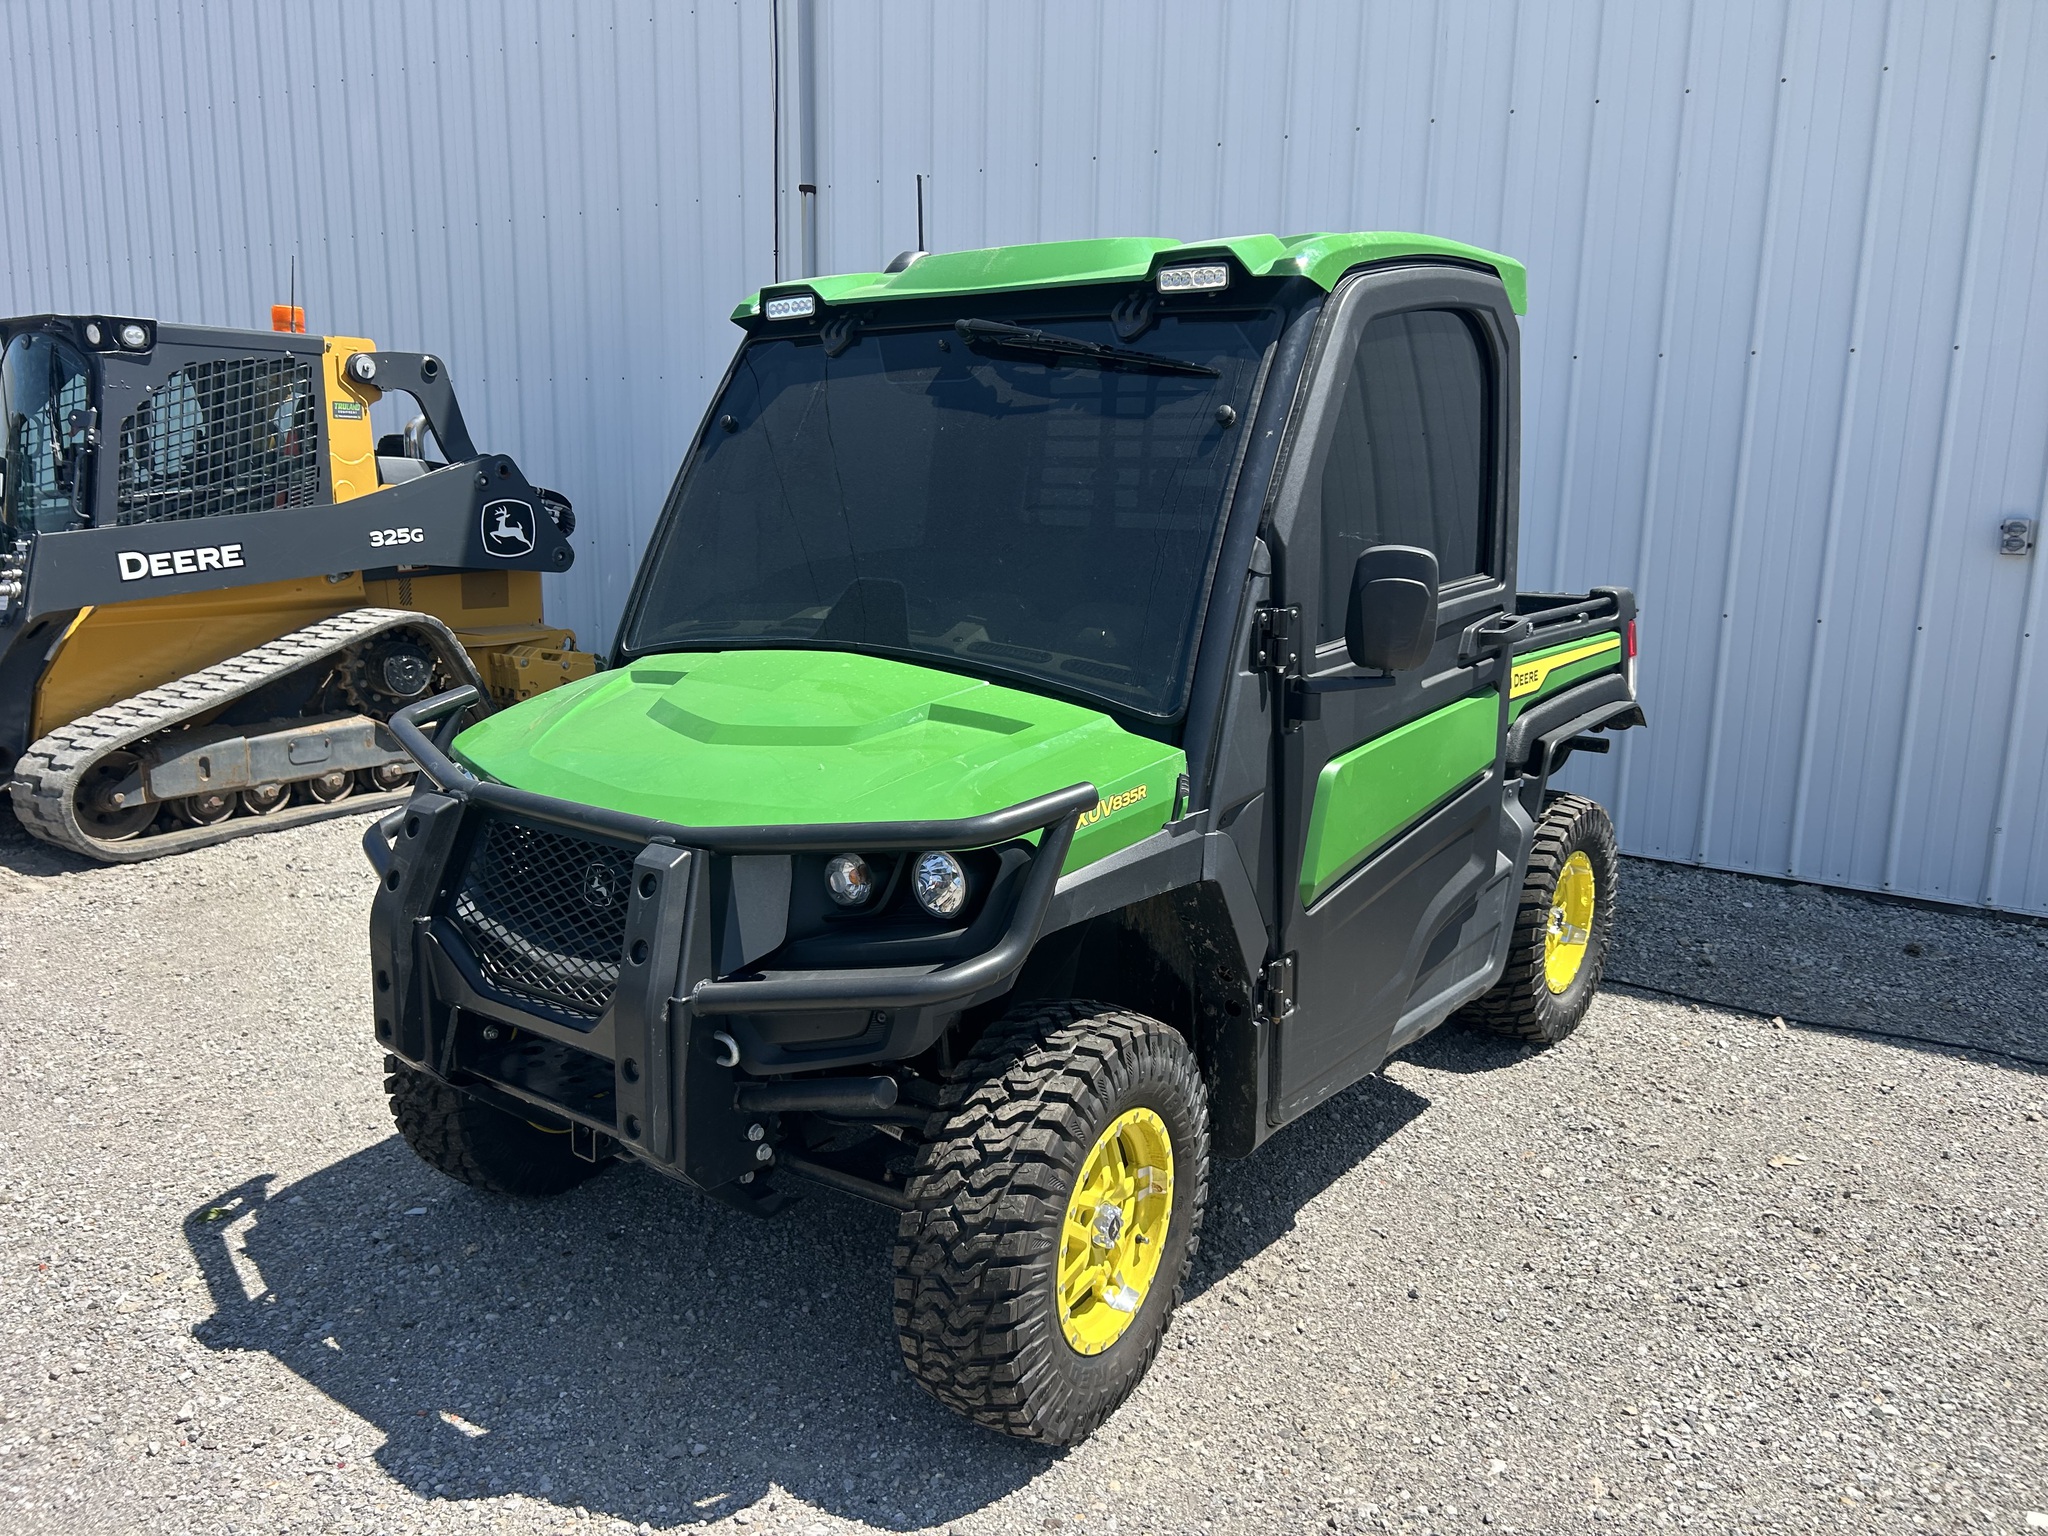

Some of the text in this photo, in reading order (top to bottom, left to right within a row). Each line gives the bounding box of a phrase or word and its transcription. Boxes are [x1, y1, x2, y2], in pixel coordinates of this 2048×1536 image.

[369, 527, 425, 547] 325G
[117, 543, 245, 581] DEERE
[1514, 669, 1539, 688] DEERE
